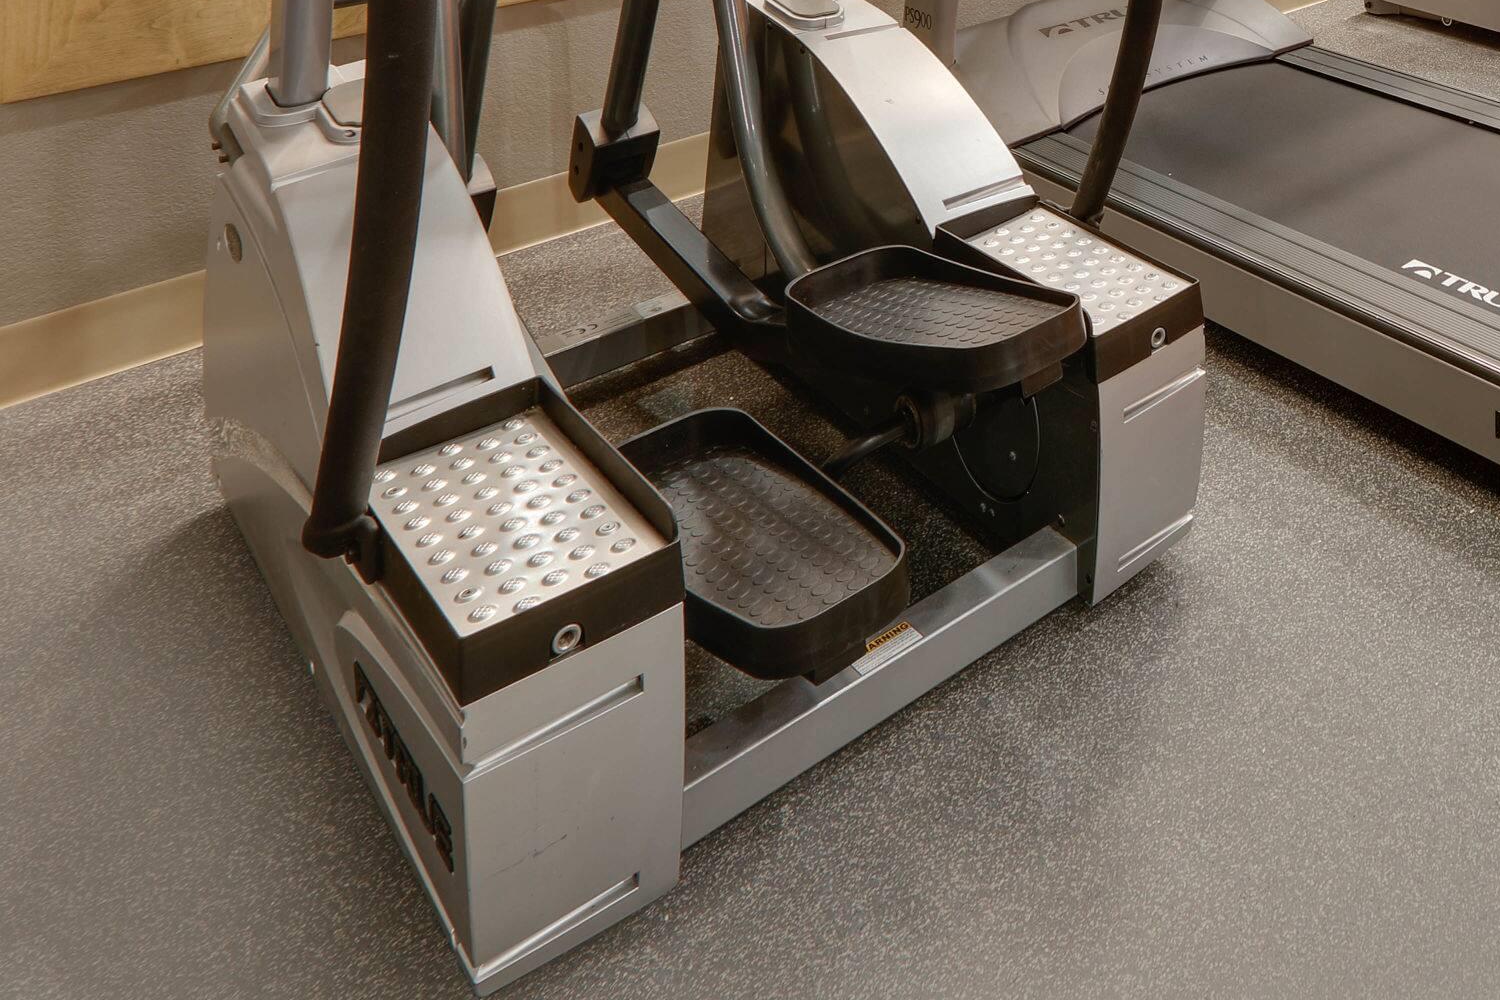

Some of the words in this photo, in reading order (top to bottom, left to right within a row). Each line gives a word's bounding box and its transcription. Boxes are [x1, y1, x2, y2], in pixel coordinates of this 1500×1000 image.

[904, 6, 932, 30] PS900
[1069, 5, 1128, 29] TRU
[868, 622, 910, 651] ARNING
